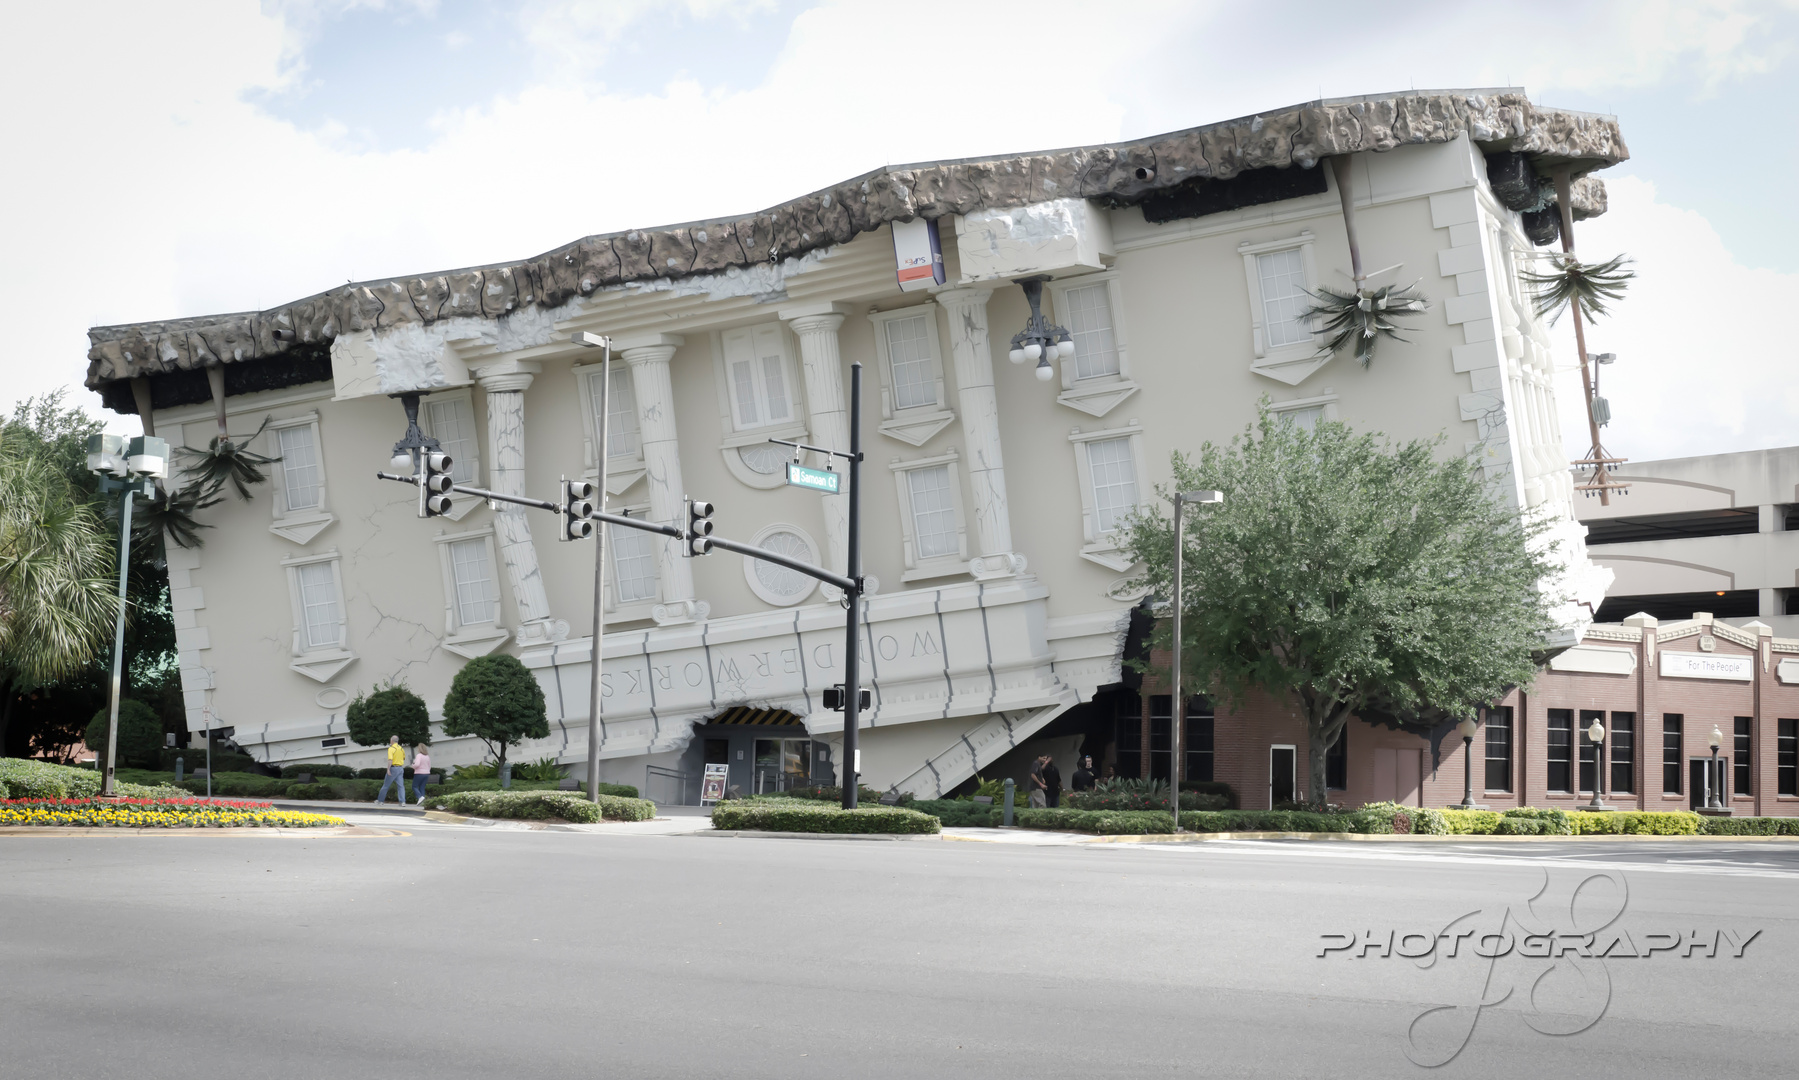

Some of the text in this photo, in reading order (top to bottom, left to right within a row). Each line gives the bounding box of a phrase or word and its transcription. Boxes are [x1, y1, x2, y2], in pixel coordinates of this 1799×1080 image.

[800, 470, 837, 489] Samoan Ct
[1702, 660, 1716, 671] The
